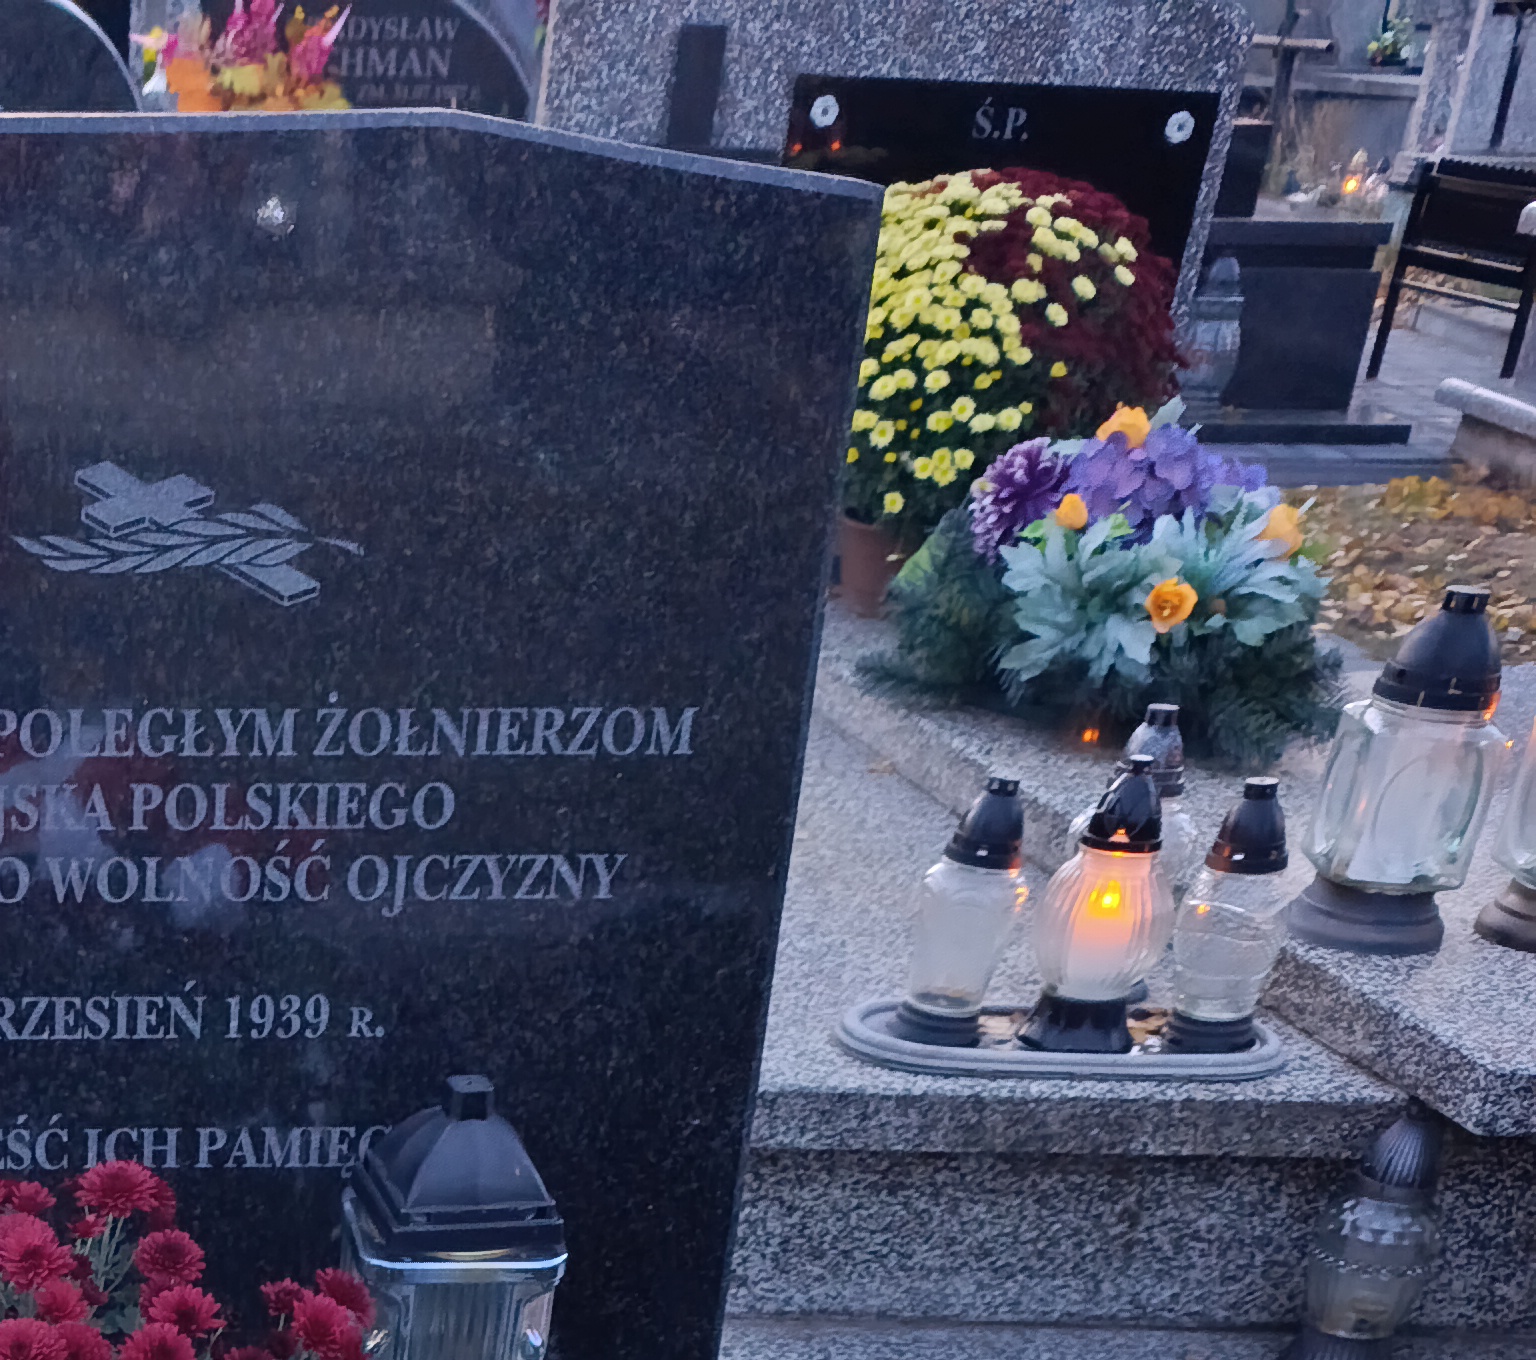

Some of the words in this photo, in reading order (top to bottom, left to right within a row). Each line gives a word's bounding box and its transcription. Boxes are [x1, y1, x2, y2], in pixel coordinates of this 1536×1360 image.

[313, 691, 700, 757] ŻOŁNIERZOM
[128, 781, 456, 831] POLSKIEGO
[46, 839, 332, 904] WOLNOŚĆ
[347, 853, 629, 918] OJCZYZNY
[225, 994, 330, 1040] 1939
[83, 1126, 183, 1169] ICH
[195, 1124, 392, 1179] PAMIĘC
